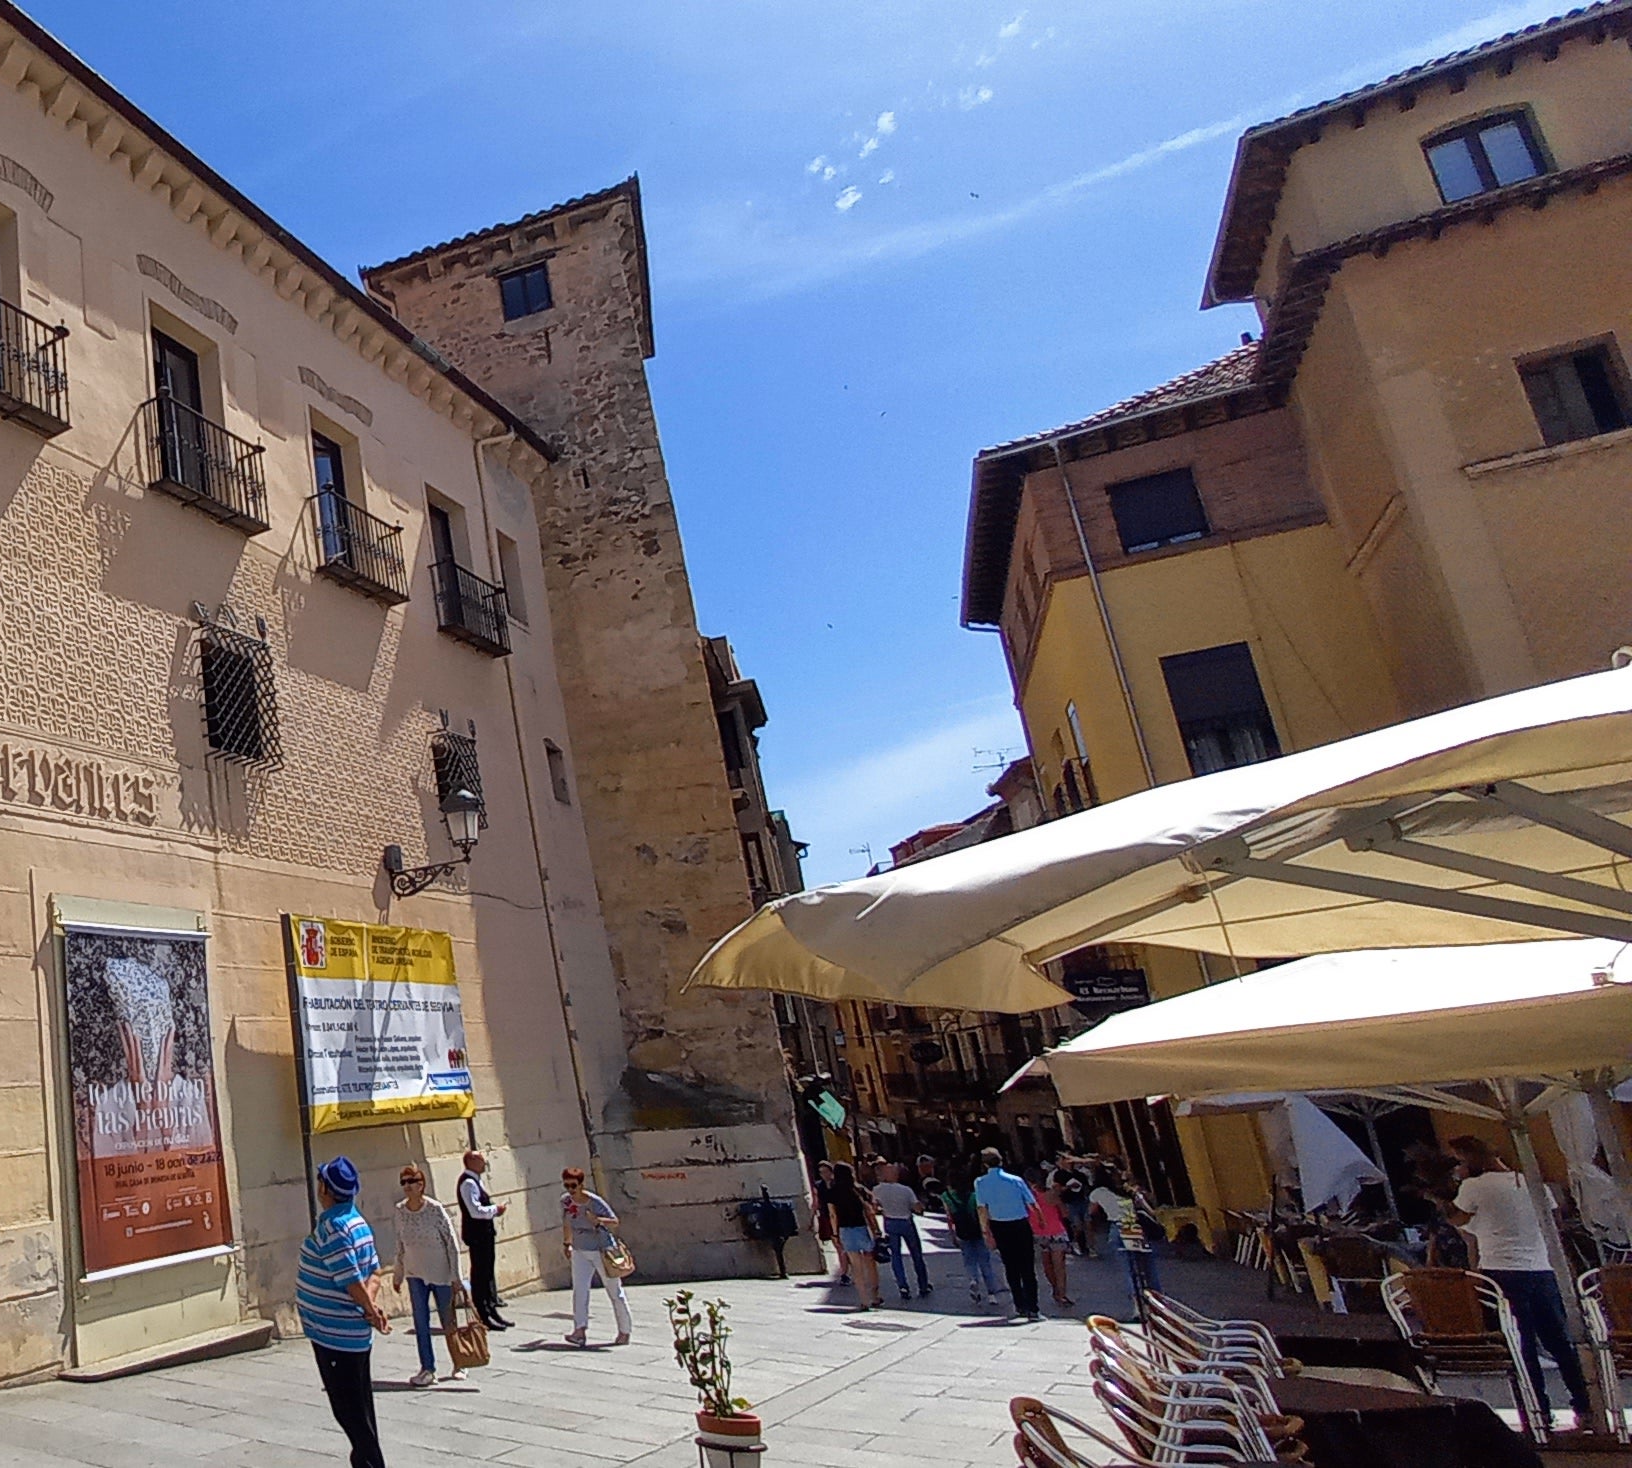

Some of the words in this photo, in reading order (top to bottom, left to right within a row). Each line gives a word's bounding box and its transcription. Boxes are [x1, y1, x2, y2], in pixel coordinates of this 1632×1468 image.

[104, 1163, 115, 1177] 18
[117, 1161, 145, 1178] junio
[155, 1158, 166, 1170] 18
